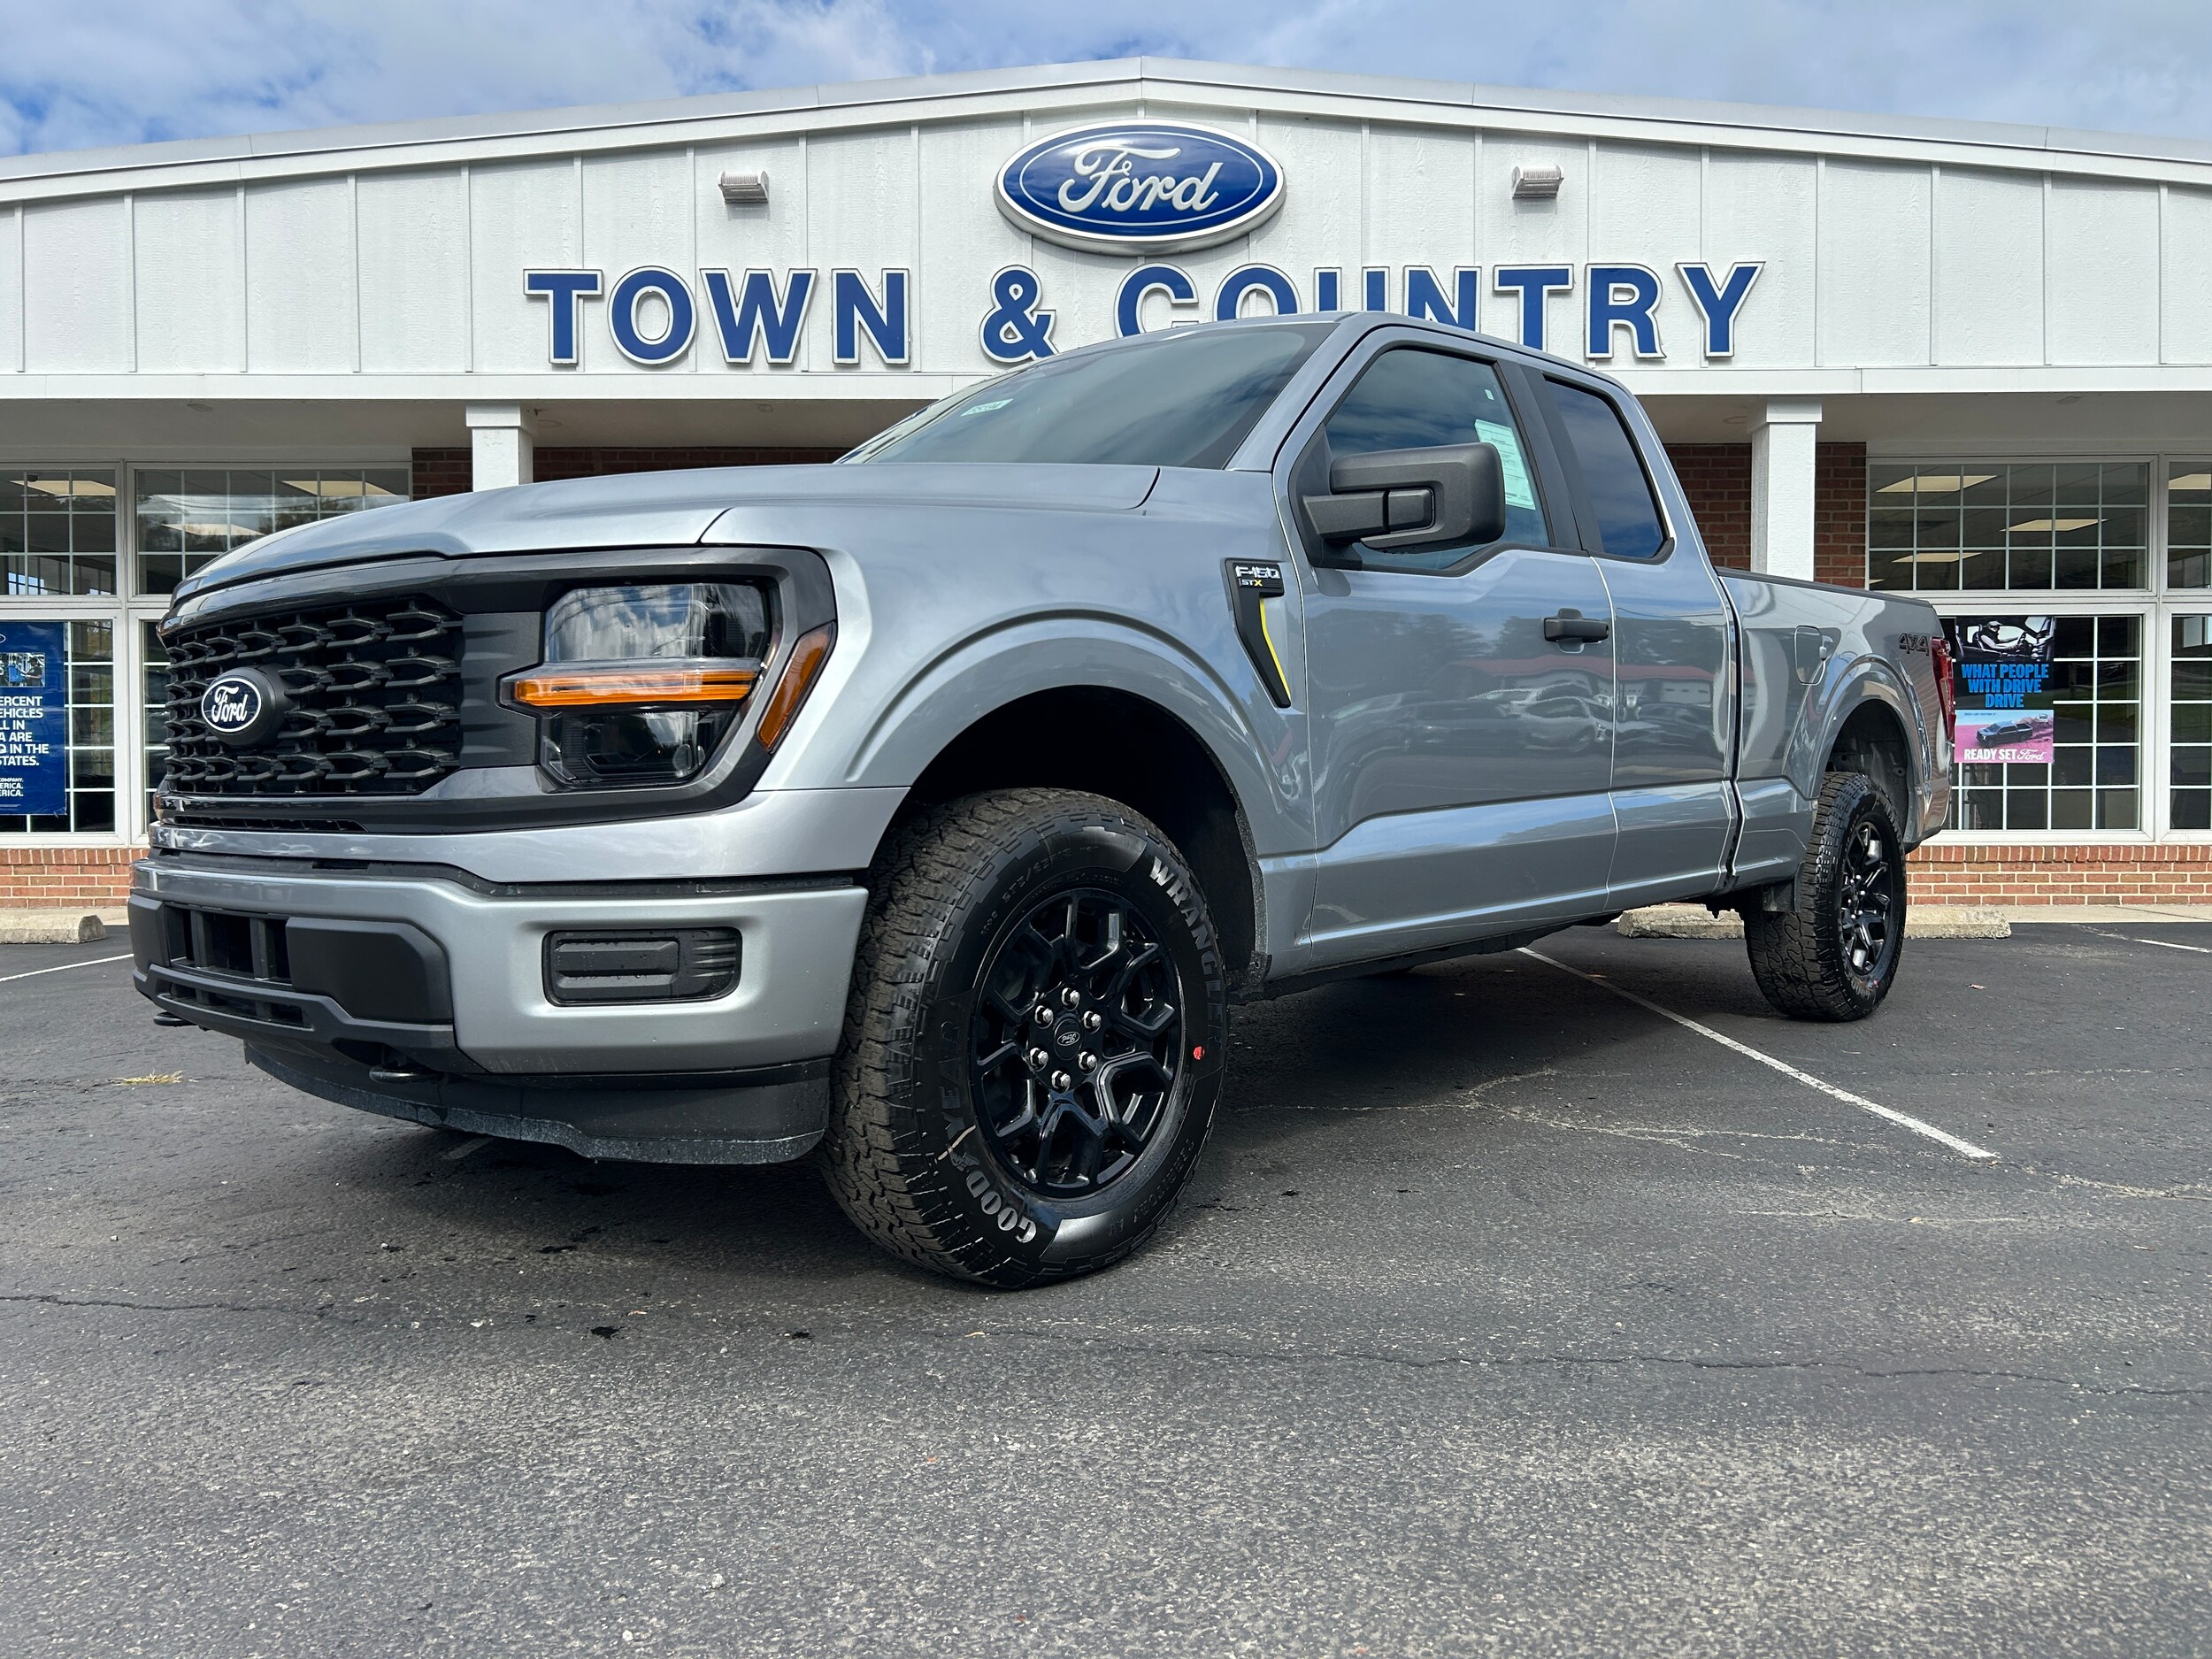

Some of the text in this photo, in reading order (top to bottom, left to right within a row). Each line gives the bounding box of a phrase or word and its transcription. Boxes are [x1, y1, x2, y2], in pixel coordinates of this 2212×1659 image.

[1058, 146, 1224, 212] Ford
[523, 265, 910, 364] TOWN
[979, 265, 1056, 363] &
[1235, 565, 1280, 579] F-150
[1962, 664, 2049, 678] WHAT PEOPLE
[1968, 679, 2042, 693] WITH DRIVE
[211, 686, 249, 723] Ford
[1985, 694, 2024, 708] DRIVE
[12, 719, 26, 731] IN
[9, 732, 34, 742] ARE
[10, 744, 22, 755] IN
[25, 744, 50, 755] THE
[1964, 749, 2047, 760] READY SET Ford
[1150, 856, 1223, 1049] WRANGLER
